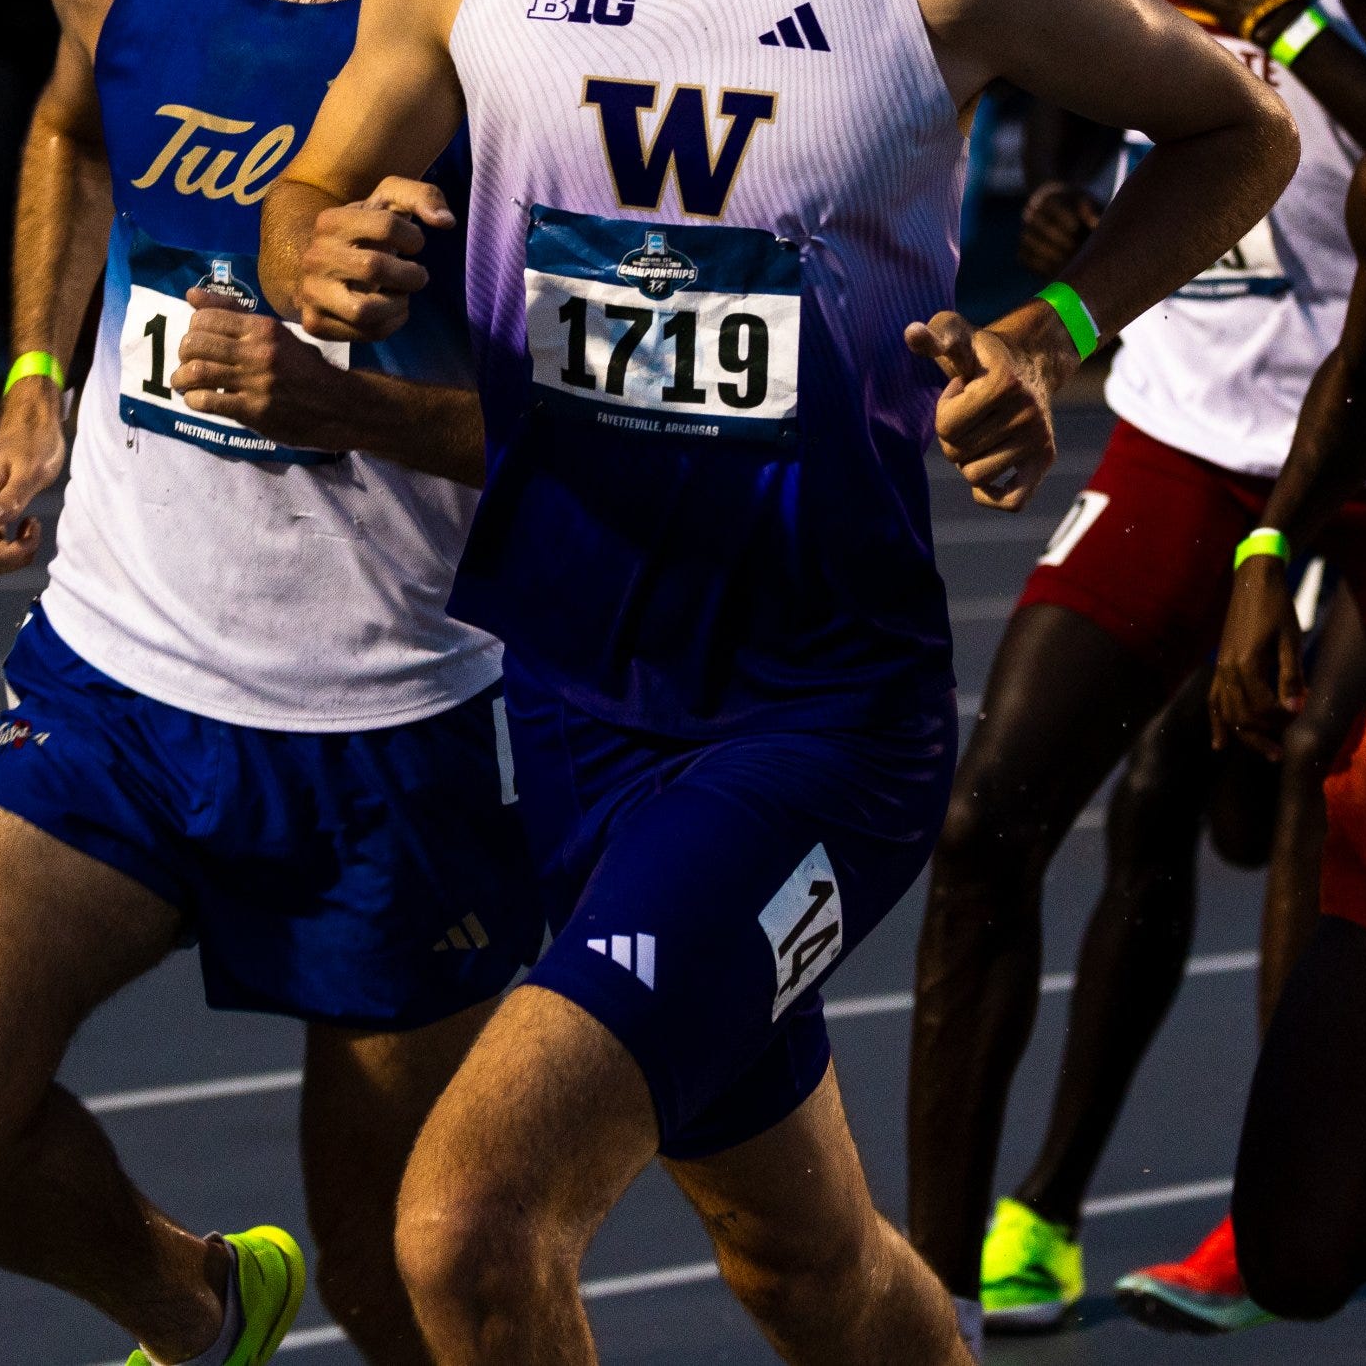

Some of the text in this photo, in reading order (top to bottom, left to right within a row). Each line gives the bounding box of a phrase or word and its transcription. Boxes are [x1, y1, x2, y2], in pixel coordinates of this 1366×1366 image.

[130, 102, 296, 206] Tul
[581, 75, 779, 220] W
[619, 264, 695, 280] CHAMPIONSHIPS
[559, 295, 770, 409] 1719
[174, 420, 227, 446] FAYETTEVILLE,
[596, 410, 662, 433] FAYETTEVILLE,
[664, 421, 721, 437] ARKANSAS
[777, 880, 840, 998] 14
